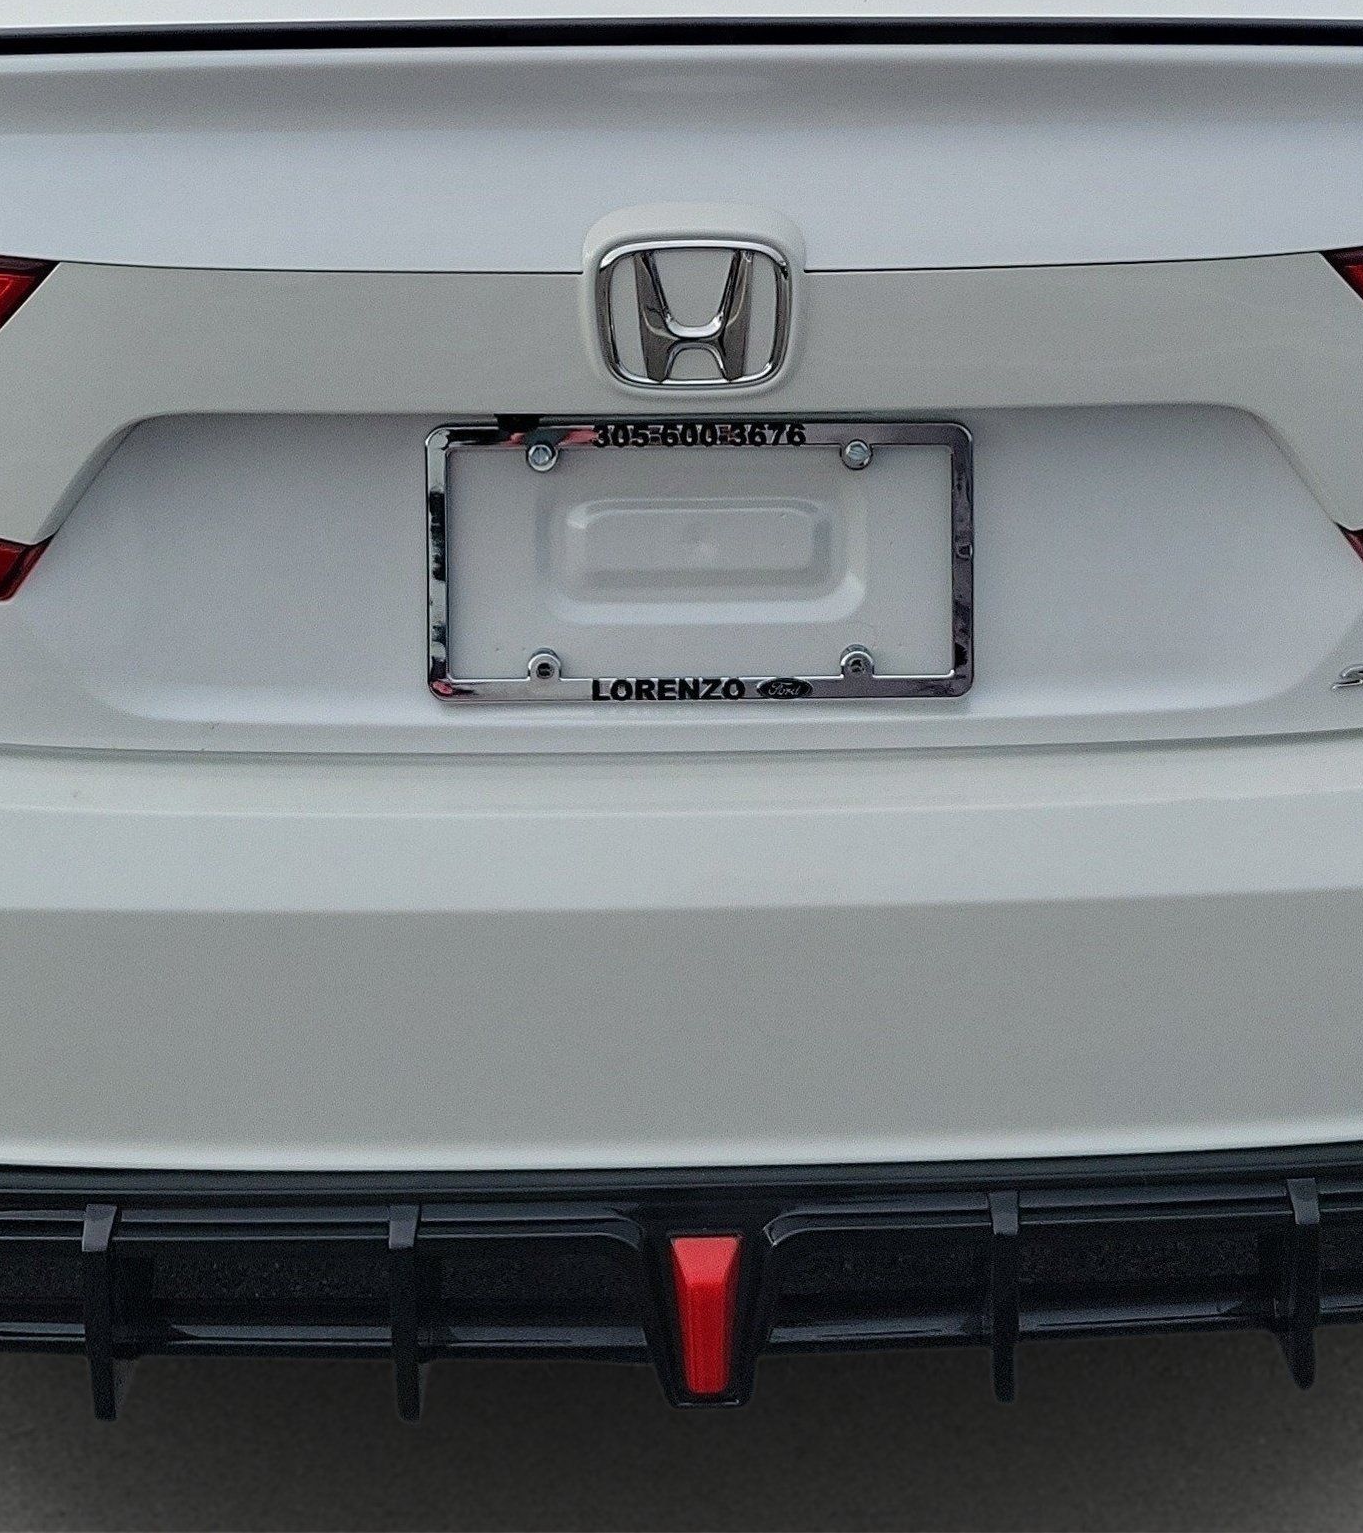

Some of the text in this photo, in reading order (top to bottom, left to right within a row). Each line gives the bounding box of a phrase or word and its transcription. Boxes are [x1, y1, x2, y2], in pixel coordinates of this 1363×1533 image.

[593, 422, 808, 448] 305-600-3676
[591, 678, 802, 701] LORENZO Ford
